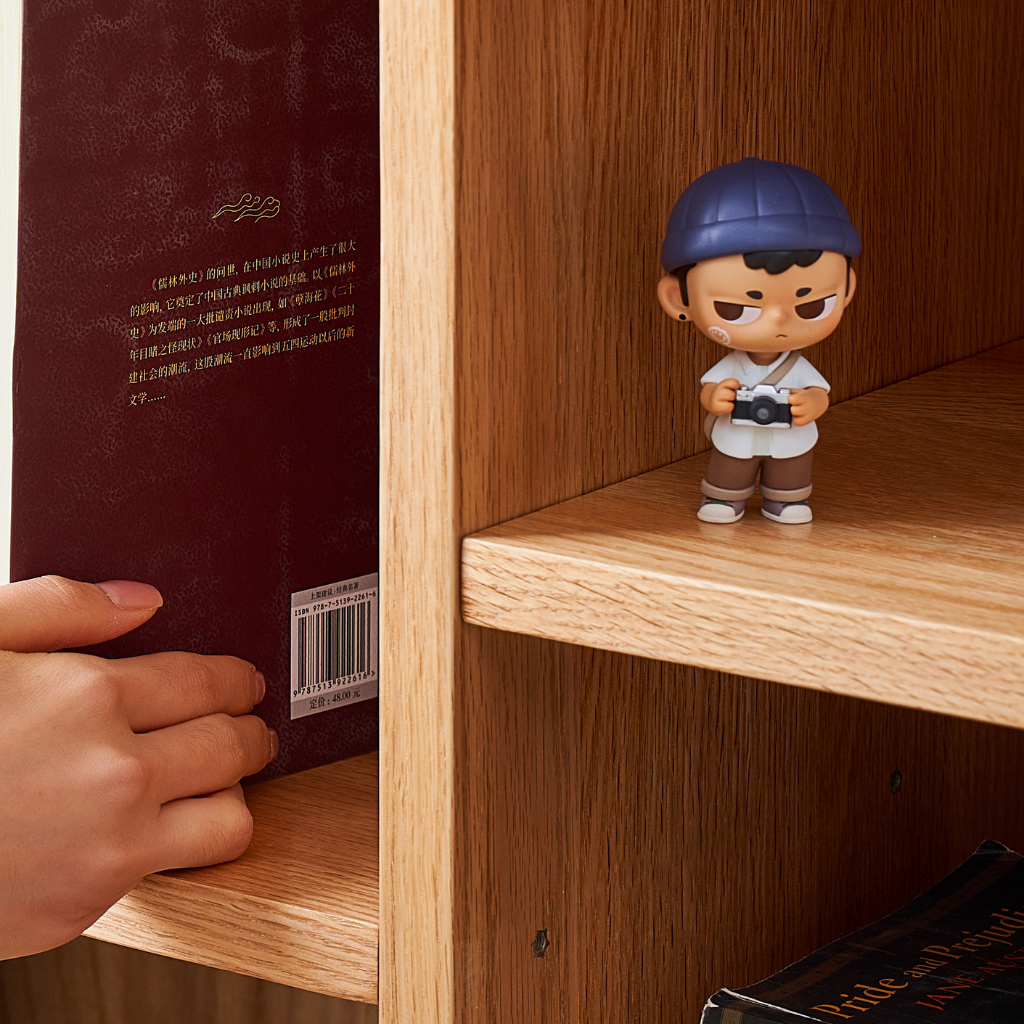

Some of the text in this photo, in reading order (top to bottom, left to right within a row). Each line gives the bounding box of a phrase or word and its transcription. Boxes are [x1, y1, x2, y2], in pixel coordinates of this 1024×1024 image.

[295, 590, 376, 617] ISBN 978-7-5139-2261-6
[301, 681, 333, 695] 787513
[337, 672, 368, 686] 922616
[810, 978, 909, 1020] Pride
[903, 957, 948, 979] and
[915, 974, 984, 1012] JANE
